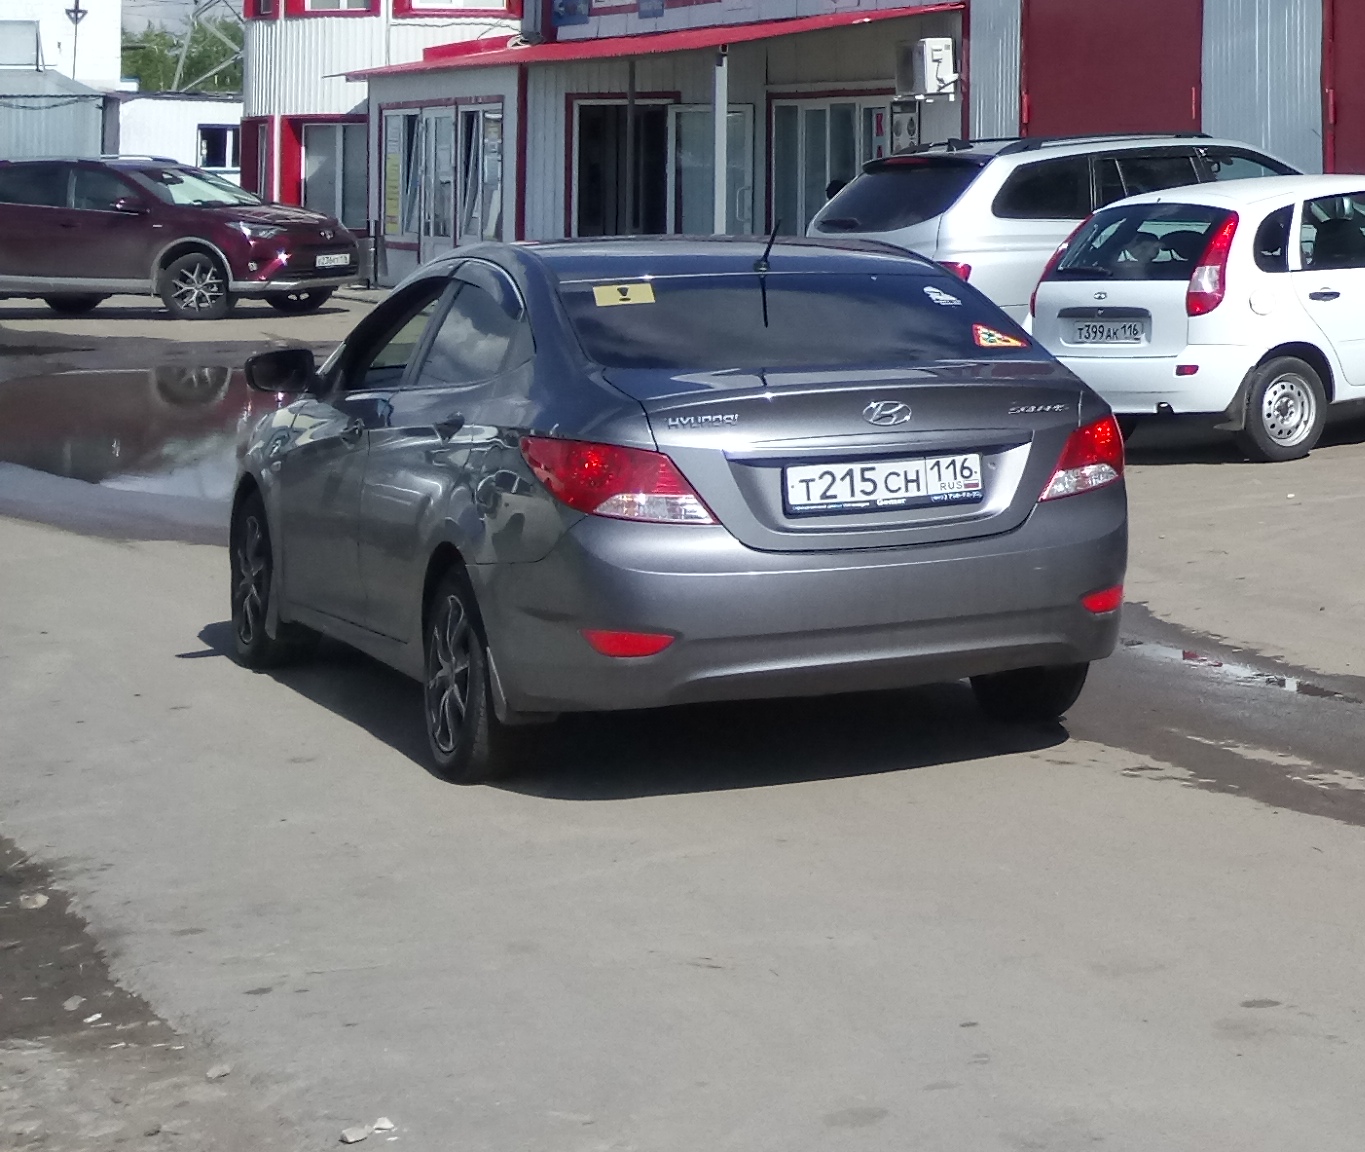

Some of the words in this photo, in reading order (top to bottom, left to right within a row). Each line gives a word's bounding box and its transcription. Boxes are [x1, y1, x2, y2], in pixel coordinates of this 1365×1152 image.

[1078, 324, 1119, 340] Т399АК
[1121, 323, 1139, 336] 116
[799, 467, 921, 501] Т215СН
[930, 458, 973, 483] 116
[940, 481, 963, 490] RUS
